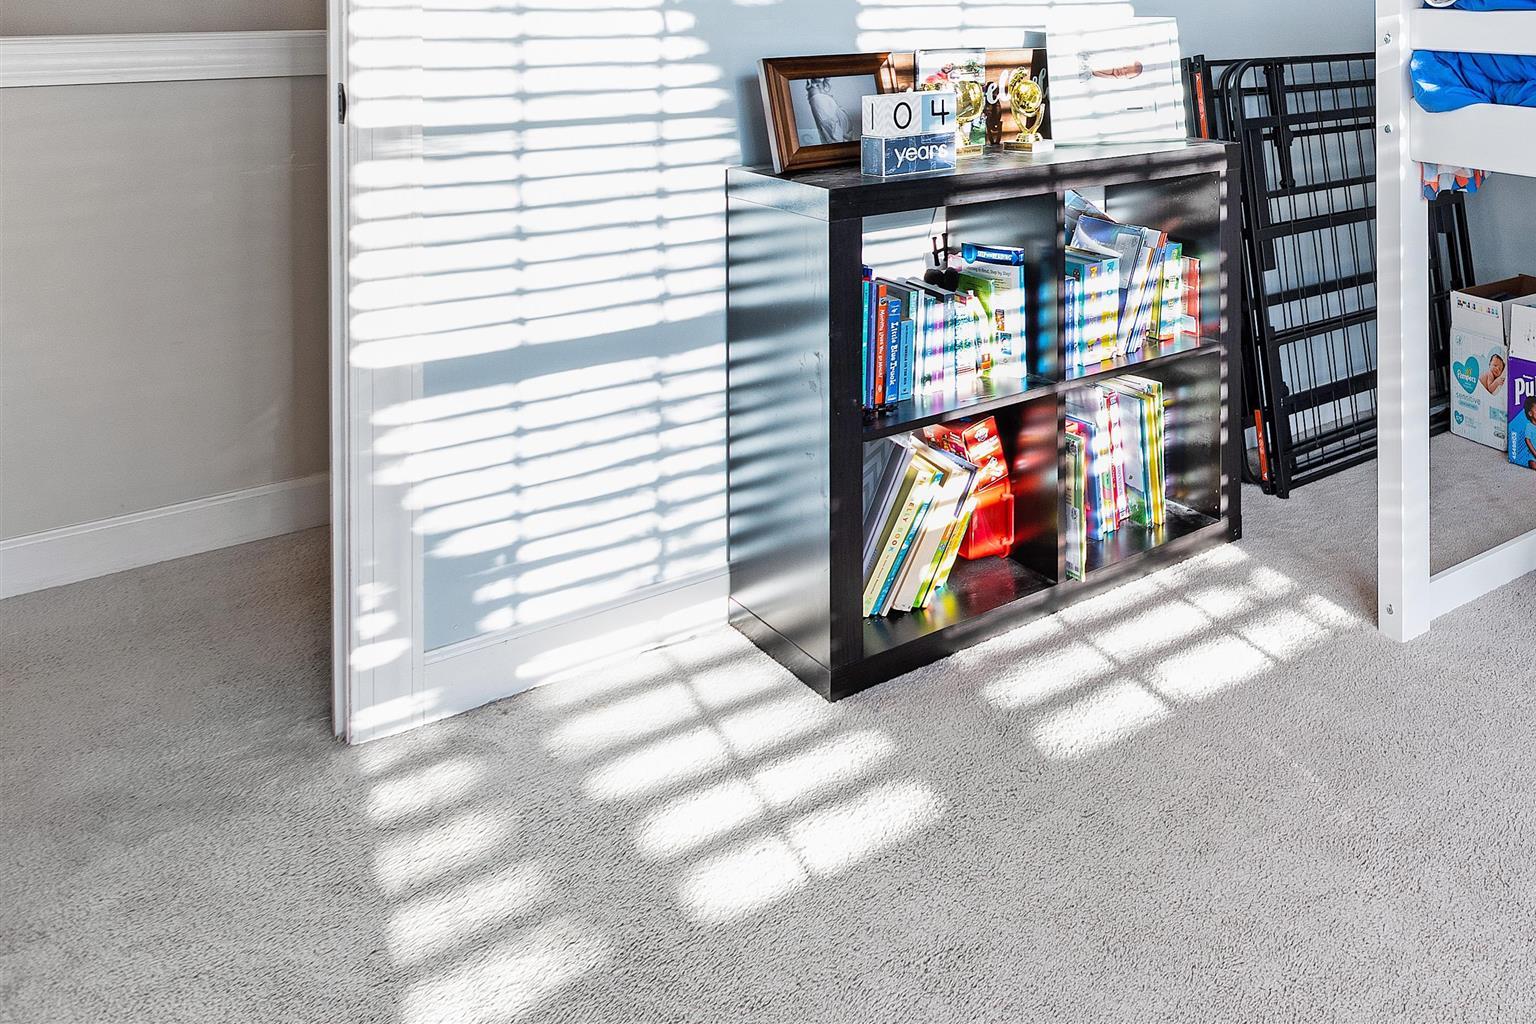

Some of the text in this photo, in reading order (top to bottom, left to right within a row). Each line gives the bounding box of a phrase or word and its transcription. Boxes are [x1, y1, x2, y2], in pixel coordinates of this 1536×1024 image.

[894, 143, 948, 168] years
[889, 321, 899, 386] Little Blue Truck
[1456, 369, 1477, 384] Pampers
